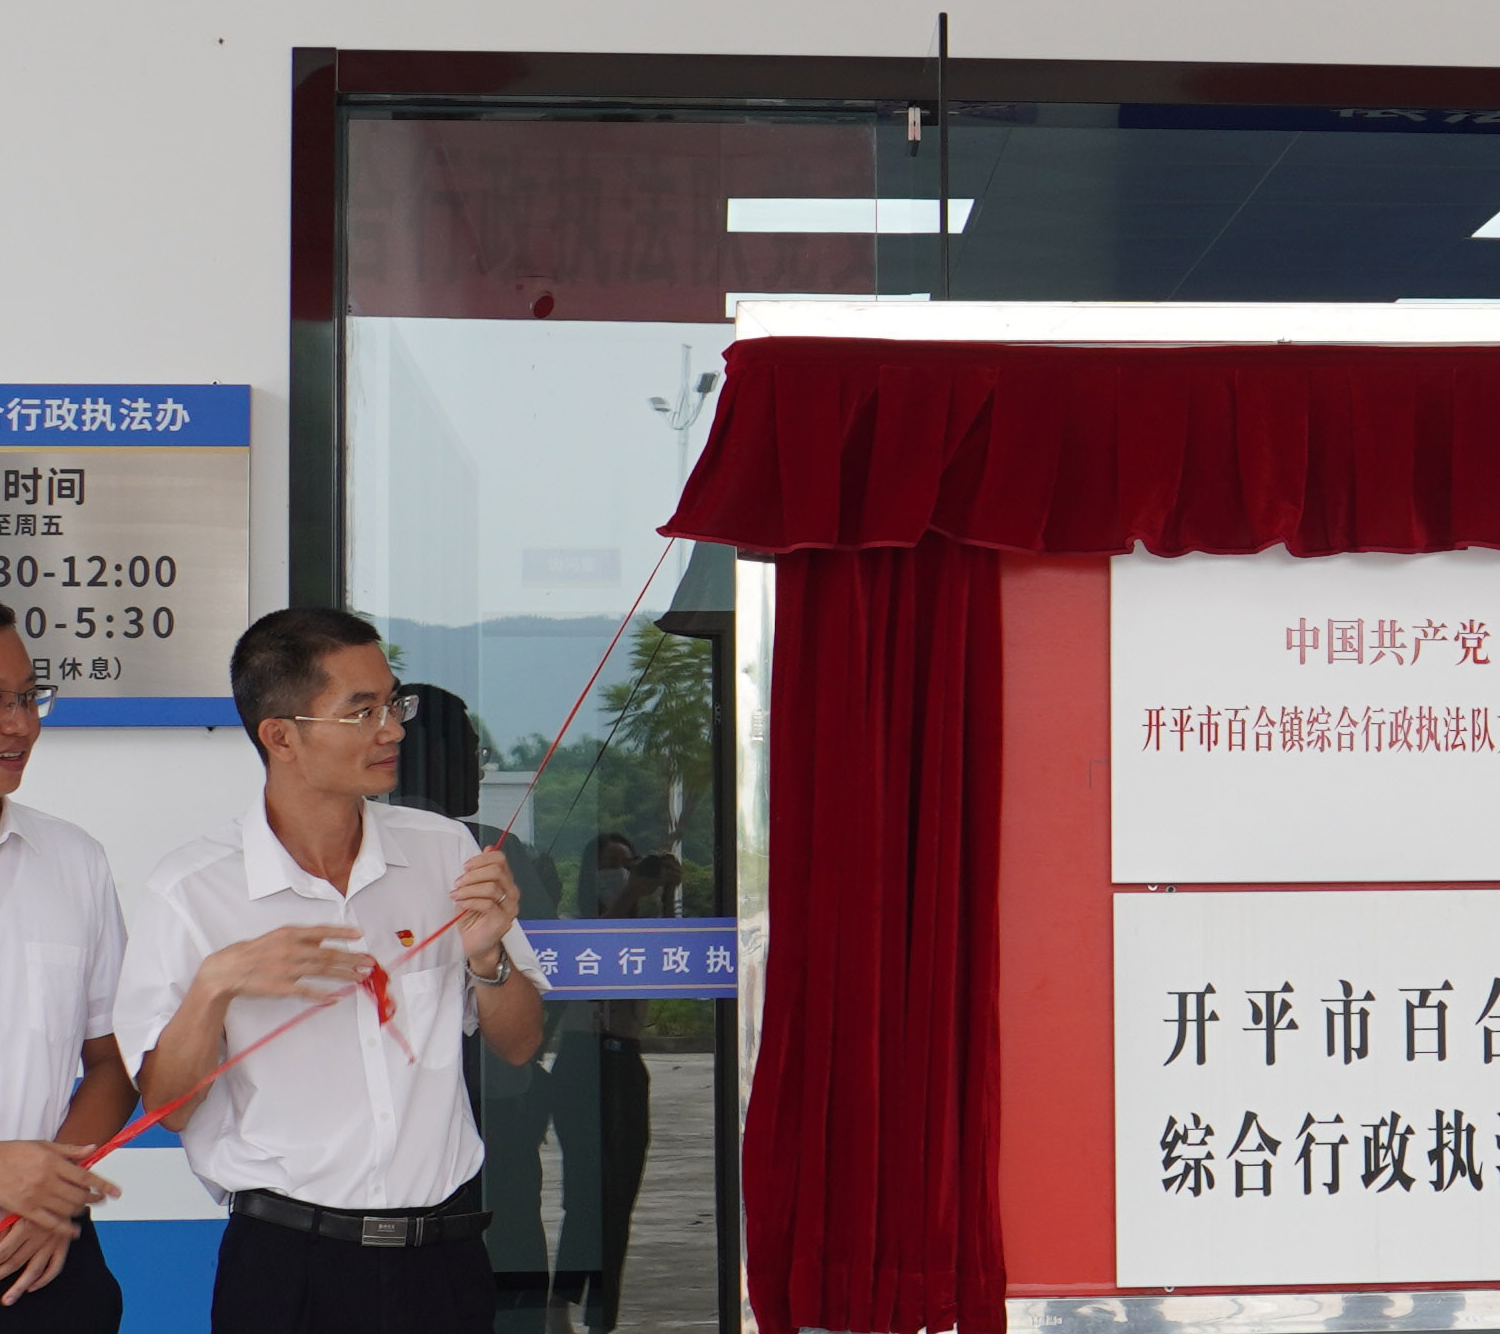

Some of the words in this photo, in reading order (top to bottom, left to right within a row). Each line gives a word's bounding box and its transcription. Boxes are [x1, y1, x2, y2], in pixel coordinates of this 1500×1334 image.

[24, 607, 176, 640] 0-5:30
[1285, 617, 1492, 667] 中国共产党
[33, 657, 123, 681] 日休息）
[534, 945, 735, 976] 综合行政执
